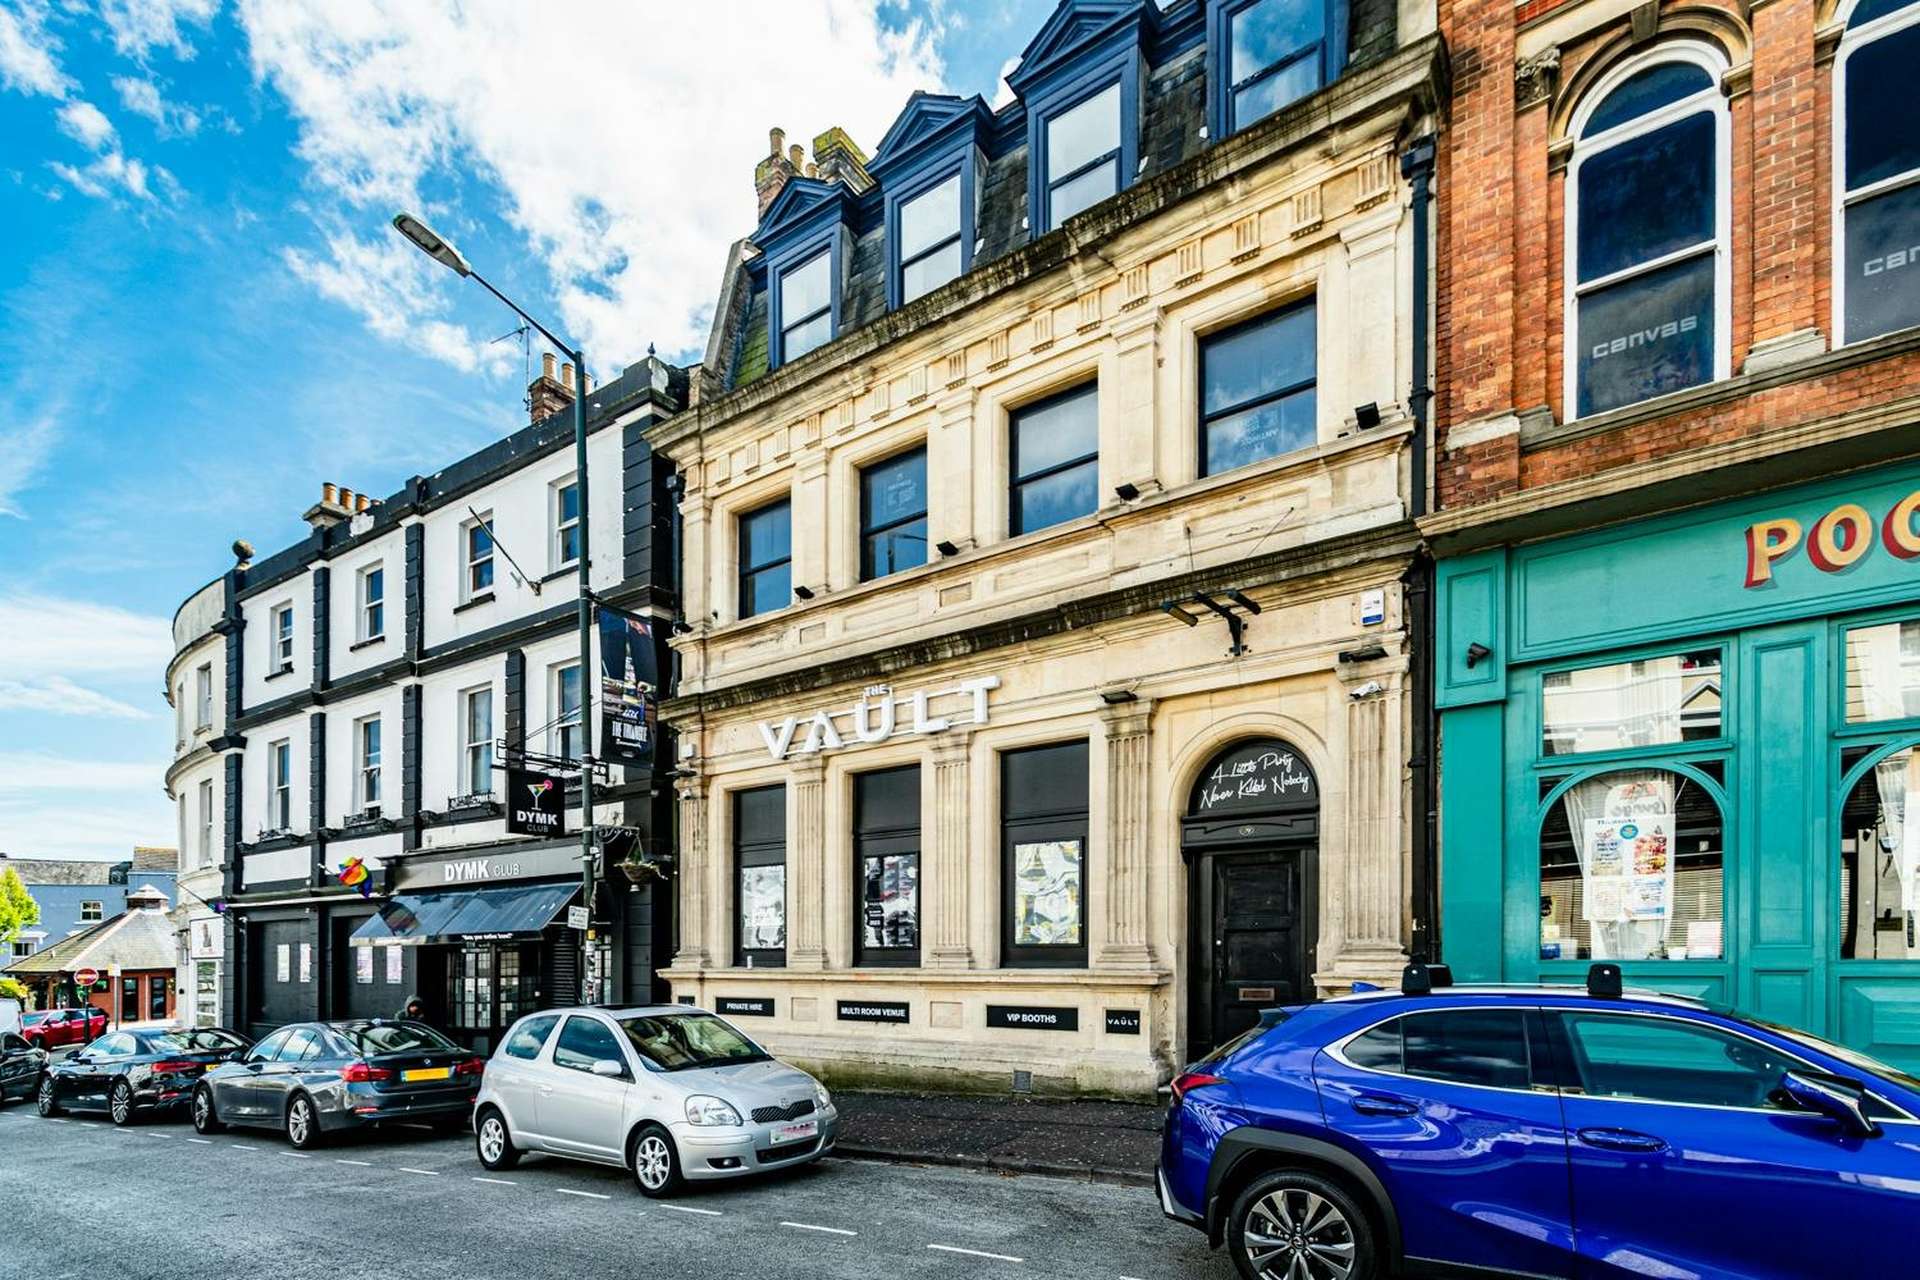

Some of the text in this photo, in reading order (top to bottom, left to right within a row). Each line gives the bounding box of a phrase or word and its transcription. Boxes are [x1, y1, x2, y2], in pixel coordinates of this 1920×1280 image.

[1592, 315, 1698, 360] canvas
[864, 684, 890, 697] THE
[758, 676, 1001, 759] VAULT
[1210, 752, 1294, 784] A Little Party
[1200, 771, 1309, 809] Never Killed Nobody
[516, 810, 558, 825] DYMK
[526, 824, 549, 833] CLUB
[444, 860, 520, 881] DYMK CLUB
[726, 1002, 763, 1011] PRIVATE HIRE
[841, 1006, 906, 1017] MULTI ROOM VENUE
[1007, 1013, 1057, 1024] VIP BOOTHS
